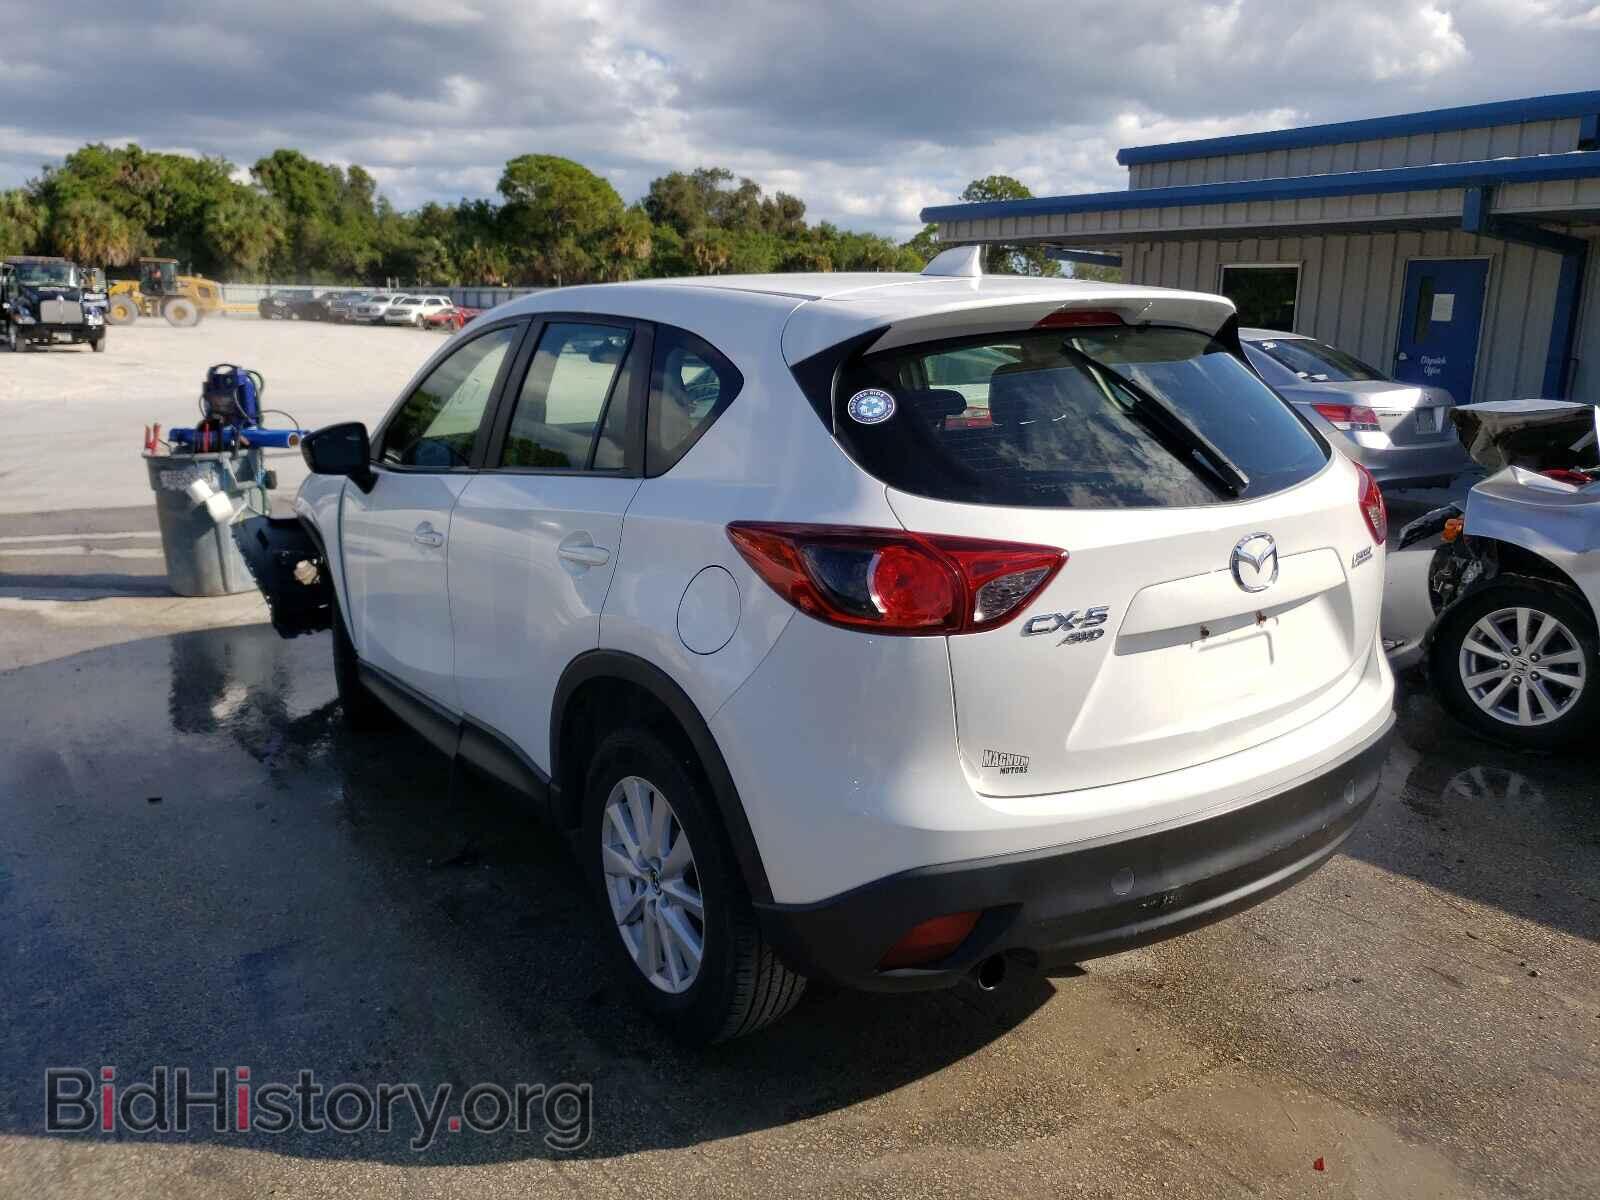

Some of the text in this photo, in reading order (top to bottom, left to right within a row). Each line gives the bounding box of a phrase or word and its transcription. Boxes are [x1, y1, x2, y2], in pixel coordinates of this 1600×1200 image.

[1022, 606, 1109, 636] CX-5
[1056, 629, 1104, 647] AWD
[982, 749, 1030, 768] MAGNUM
[1000, 766, 1028, 775] MOTORS
